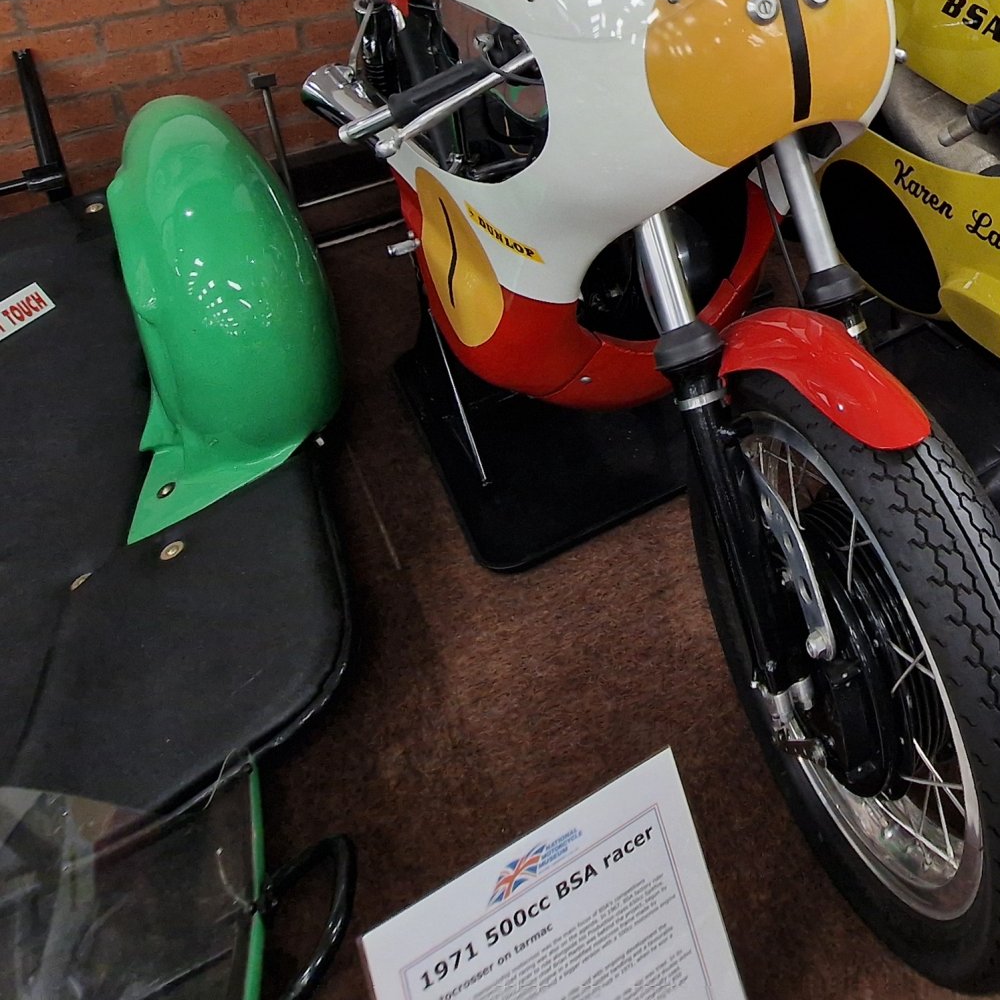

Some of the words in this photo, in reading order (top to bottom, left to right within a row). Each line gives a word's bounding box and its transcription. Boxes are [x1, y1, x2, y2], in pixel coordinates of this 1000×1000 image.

[894, 158, 955, 220] Karen
[478, 215, 535, 258] DUNLOP
[2, 291, 48, 326] TOUCH
[421, 942, 479, 990] 1971
[485, 896, 552, 949] 500cc
[555, 863, 599, 901] BSA
[602, 826, 654, 870] racer
[496, 952, 512, 966] on
[515, 923, 554, 954] tarmac
